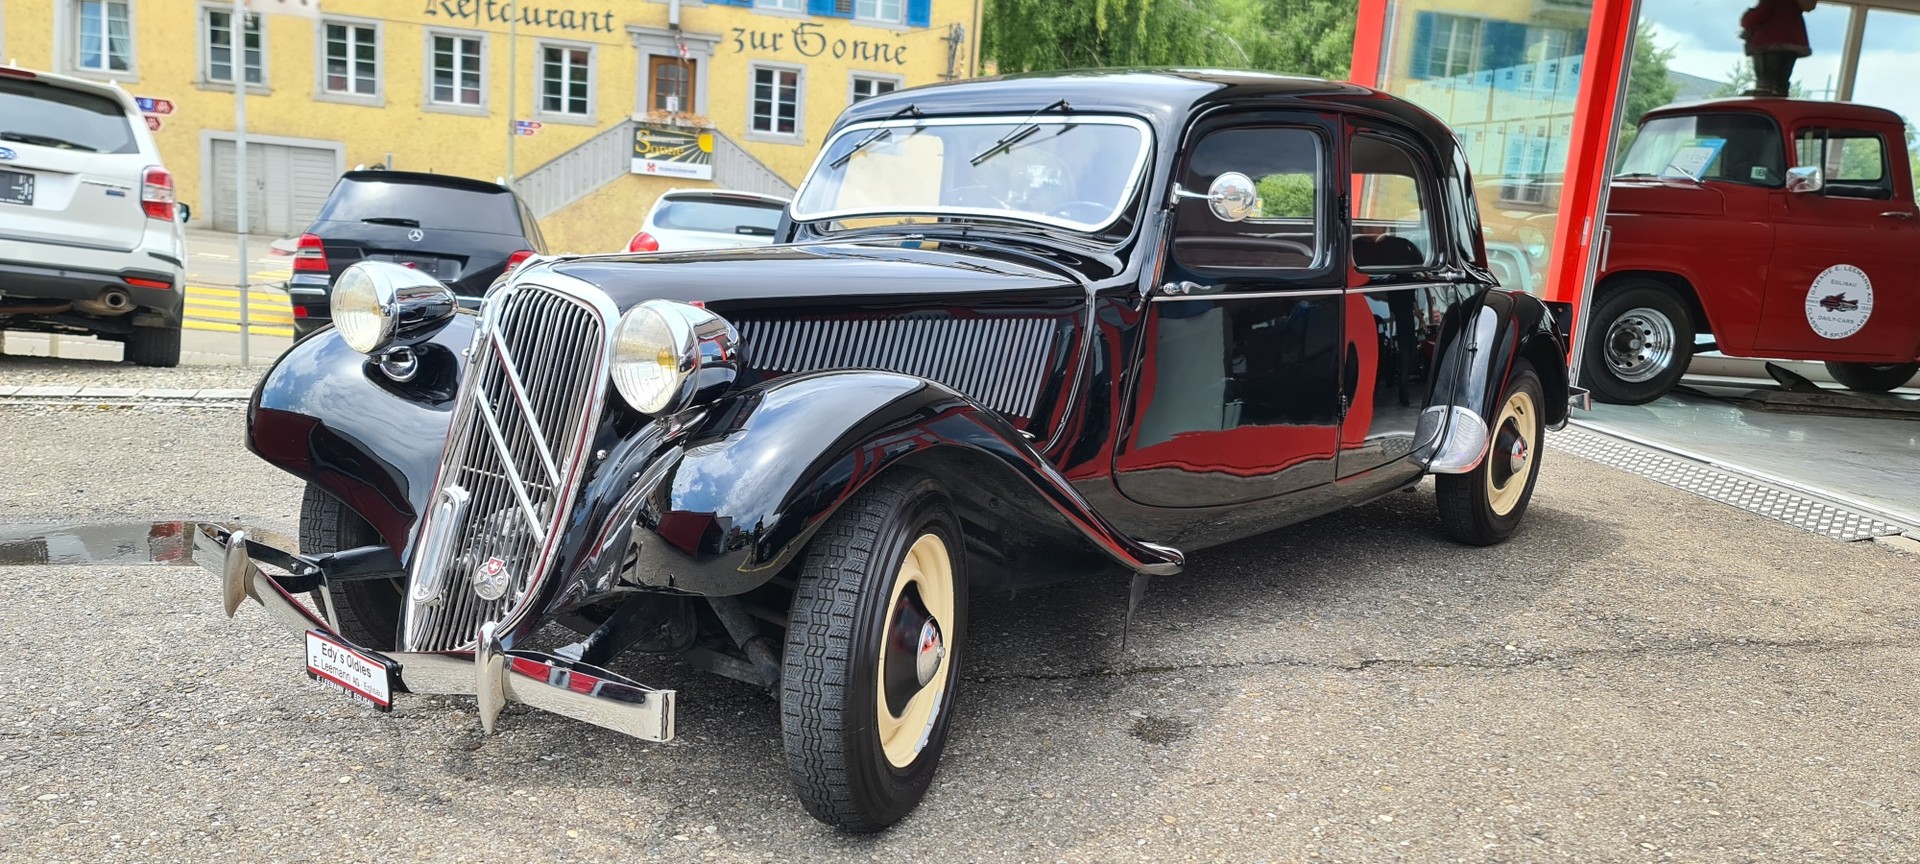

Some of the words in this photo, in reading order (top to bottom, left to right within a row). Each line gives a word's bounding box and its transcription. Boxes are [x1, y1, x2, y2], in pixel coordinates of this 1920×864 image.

[731, 27, 784, 53] zur
[791, 22, 907, 65] Sonne
[1811, 268, 1833, 295] GARAGE
[1844, 266, 1871, 290] LEEMANN
[1807, 307, 1823, 334] CLASSIC
[1829, 315, 1867, 338] SPORTCARS
[1818, 315, 1854, 324] DAILY-CARS
[320, 659, 351, 682] Leemann
[346, 654, 372, 678] Oldies
